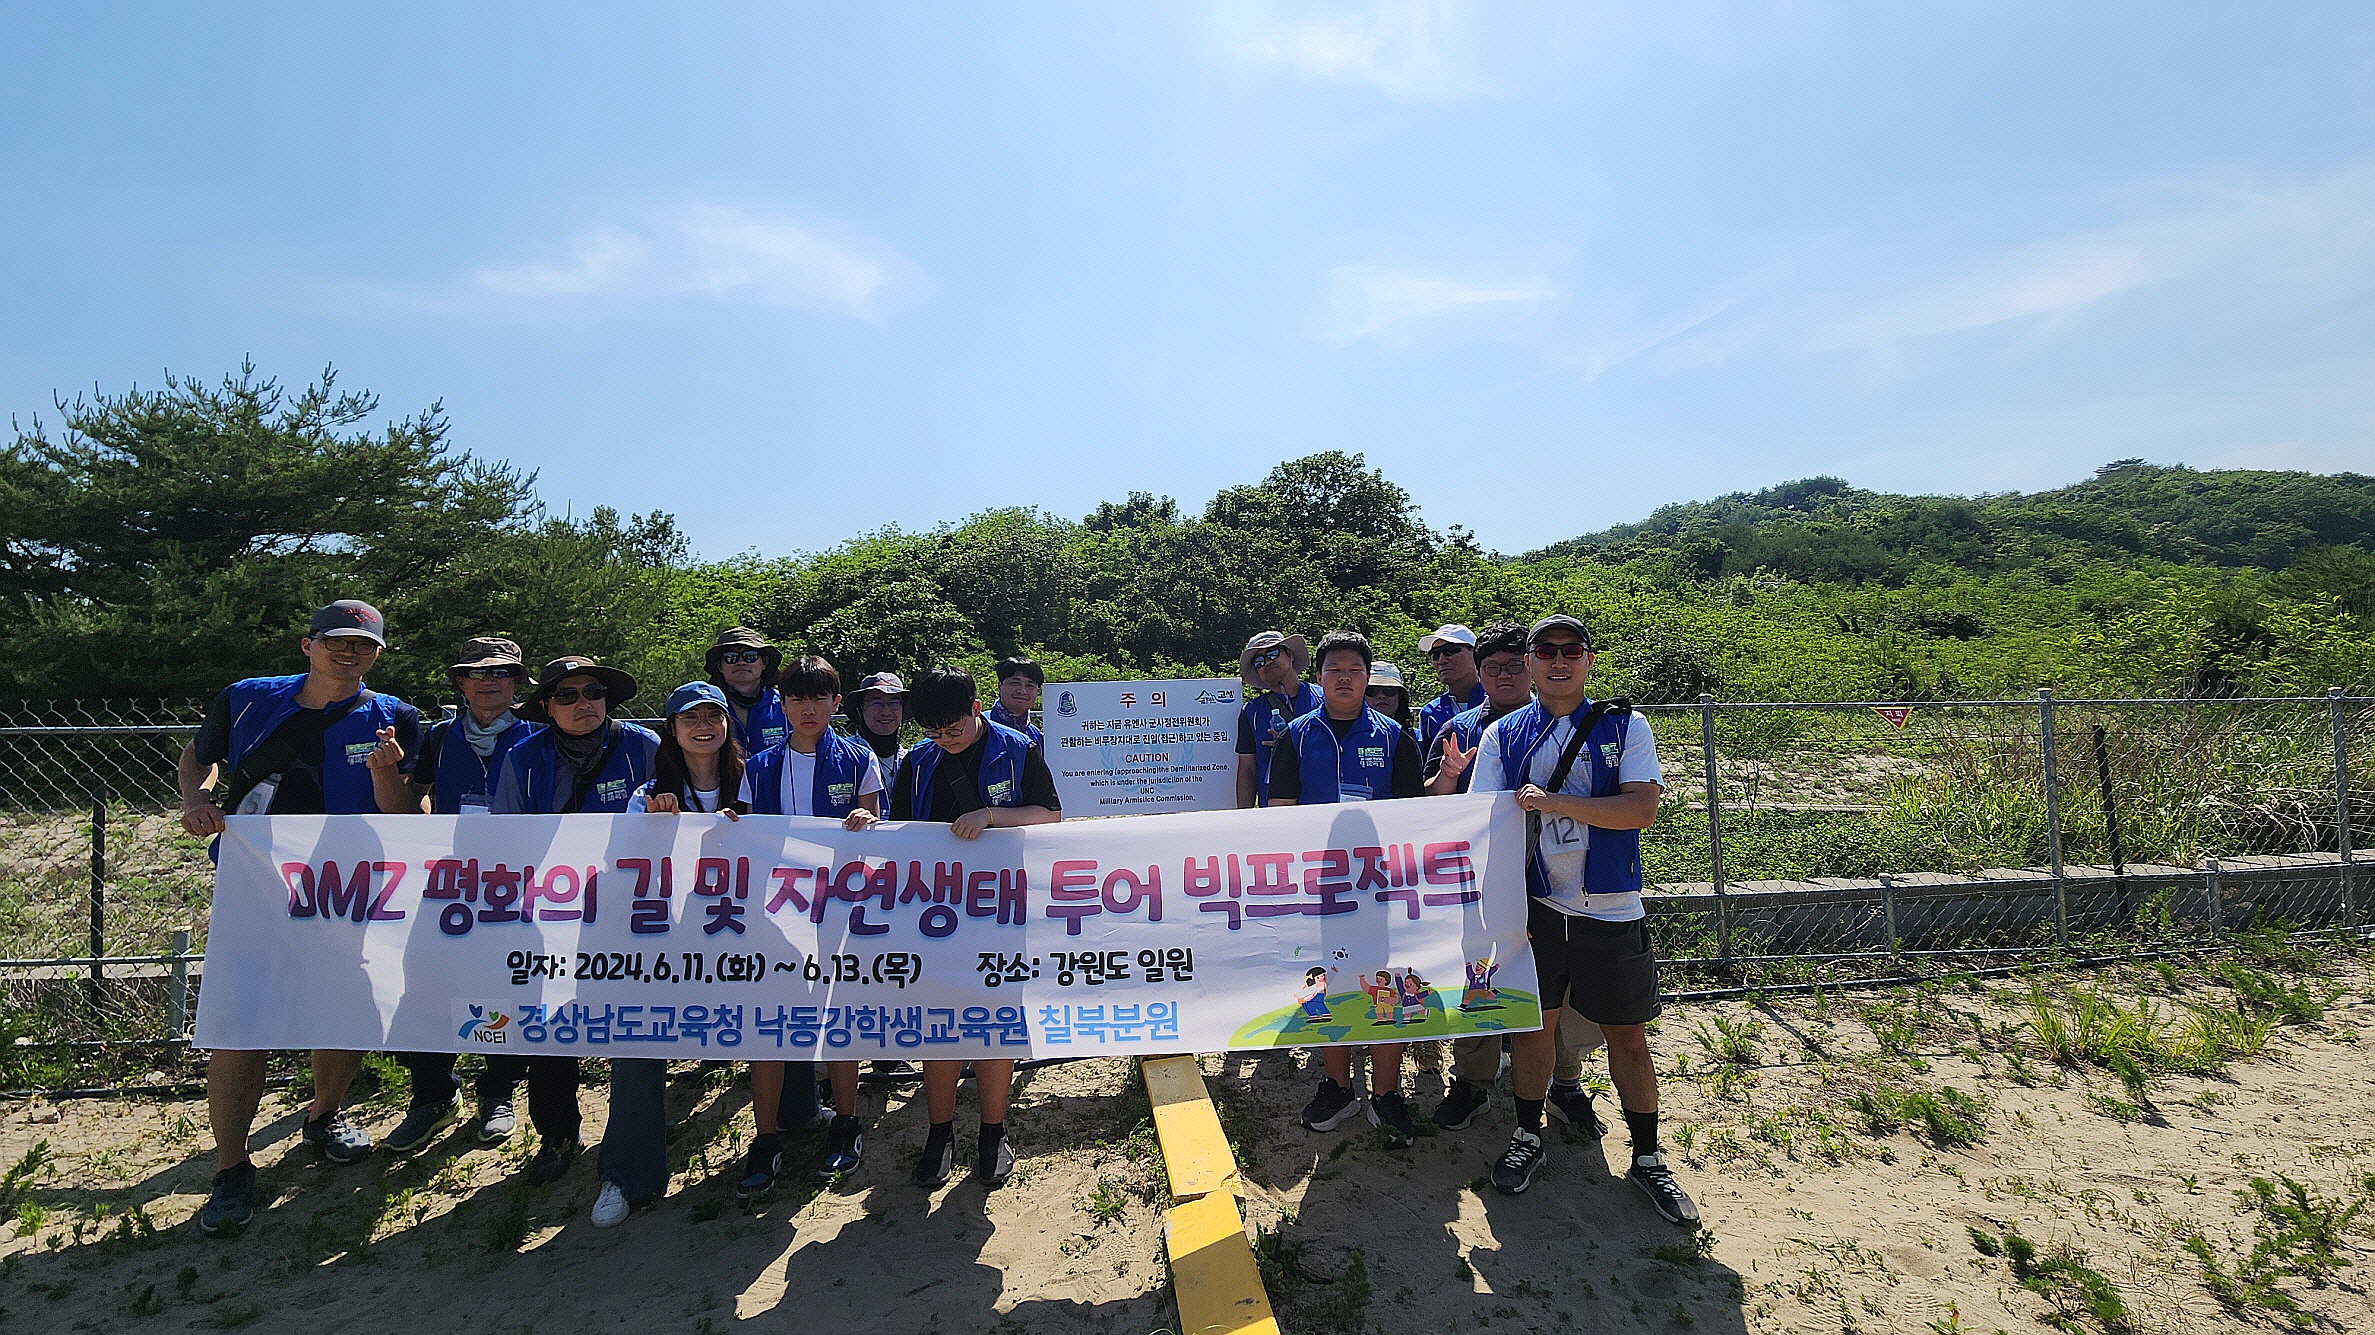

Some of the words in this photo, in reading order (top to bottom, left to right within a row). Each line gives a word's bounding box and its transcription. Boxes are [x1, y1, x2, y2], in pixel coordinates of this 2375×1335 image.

[1081, 720, 1105, 731] 귀하는
[1106, 719, 1123, 730] 지금
[1124, 718, 1147, 730] 유엔사
[1148, 715, 1210, 729] 군사정전위원회가
[1060, 737, 1093, 748] 관할하는
[1094, 734, 1141, 747] 비무장지대로
[1142, 732, 1194, 745] 진입(접근)하고
[1195, 731, 1211, 742] 있는
[1125, 753, 1169, 764] CAUTION
[1061, 770, 1074, 778] You
[1086, 768, 1113, 777] entering
[1170, 763, 1211, 773] Demilitarized
[1090, 779, 1109, 787] which
[1117, 778, 1136, 786] under
[1148, 776, 1184, 786] jurisdiction
[1184, 775, 1192, 783] of
[1192, 775, 1203, 783] the
[1140, 787, 1155, 795] UNC
[1099, 797, 1123, 806] Military
[1124, 796, 1155, 804] Armistice
[1546, 816, 1580, 845] 12
[281, 860, 407, 923] DMZ
[423, 858, 598, 936] 평화의
[616, 857, 673, 935] 길
[694, 857, 749, 936] 및
[765, 860, 1028, 938] 자연생태
[1045, 863, 1163, 936] 투어
[1183, 841, 1481, 931] 빅프로젝트
[507, 951, 566, 985] 일자:
[574, 952, 766, 984] 2024.6.11.(화)
[803, 952, 922, 988] 6.13.(목)
[976, 952, 1040, 987] 장소:
[1050, 951, 1130, 986] 강원도
[1137, 948, 1193, 982] 일원
[517, 1003, 743, 1046] 경상남도교육청
[754, 1004, 1029, 1048] 낙동강학생교육원
[1038, 1001, 1179, 1045] 칠북분원
[474, 1030, 506, 1044] NCEI
